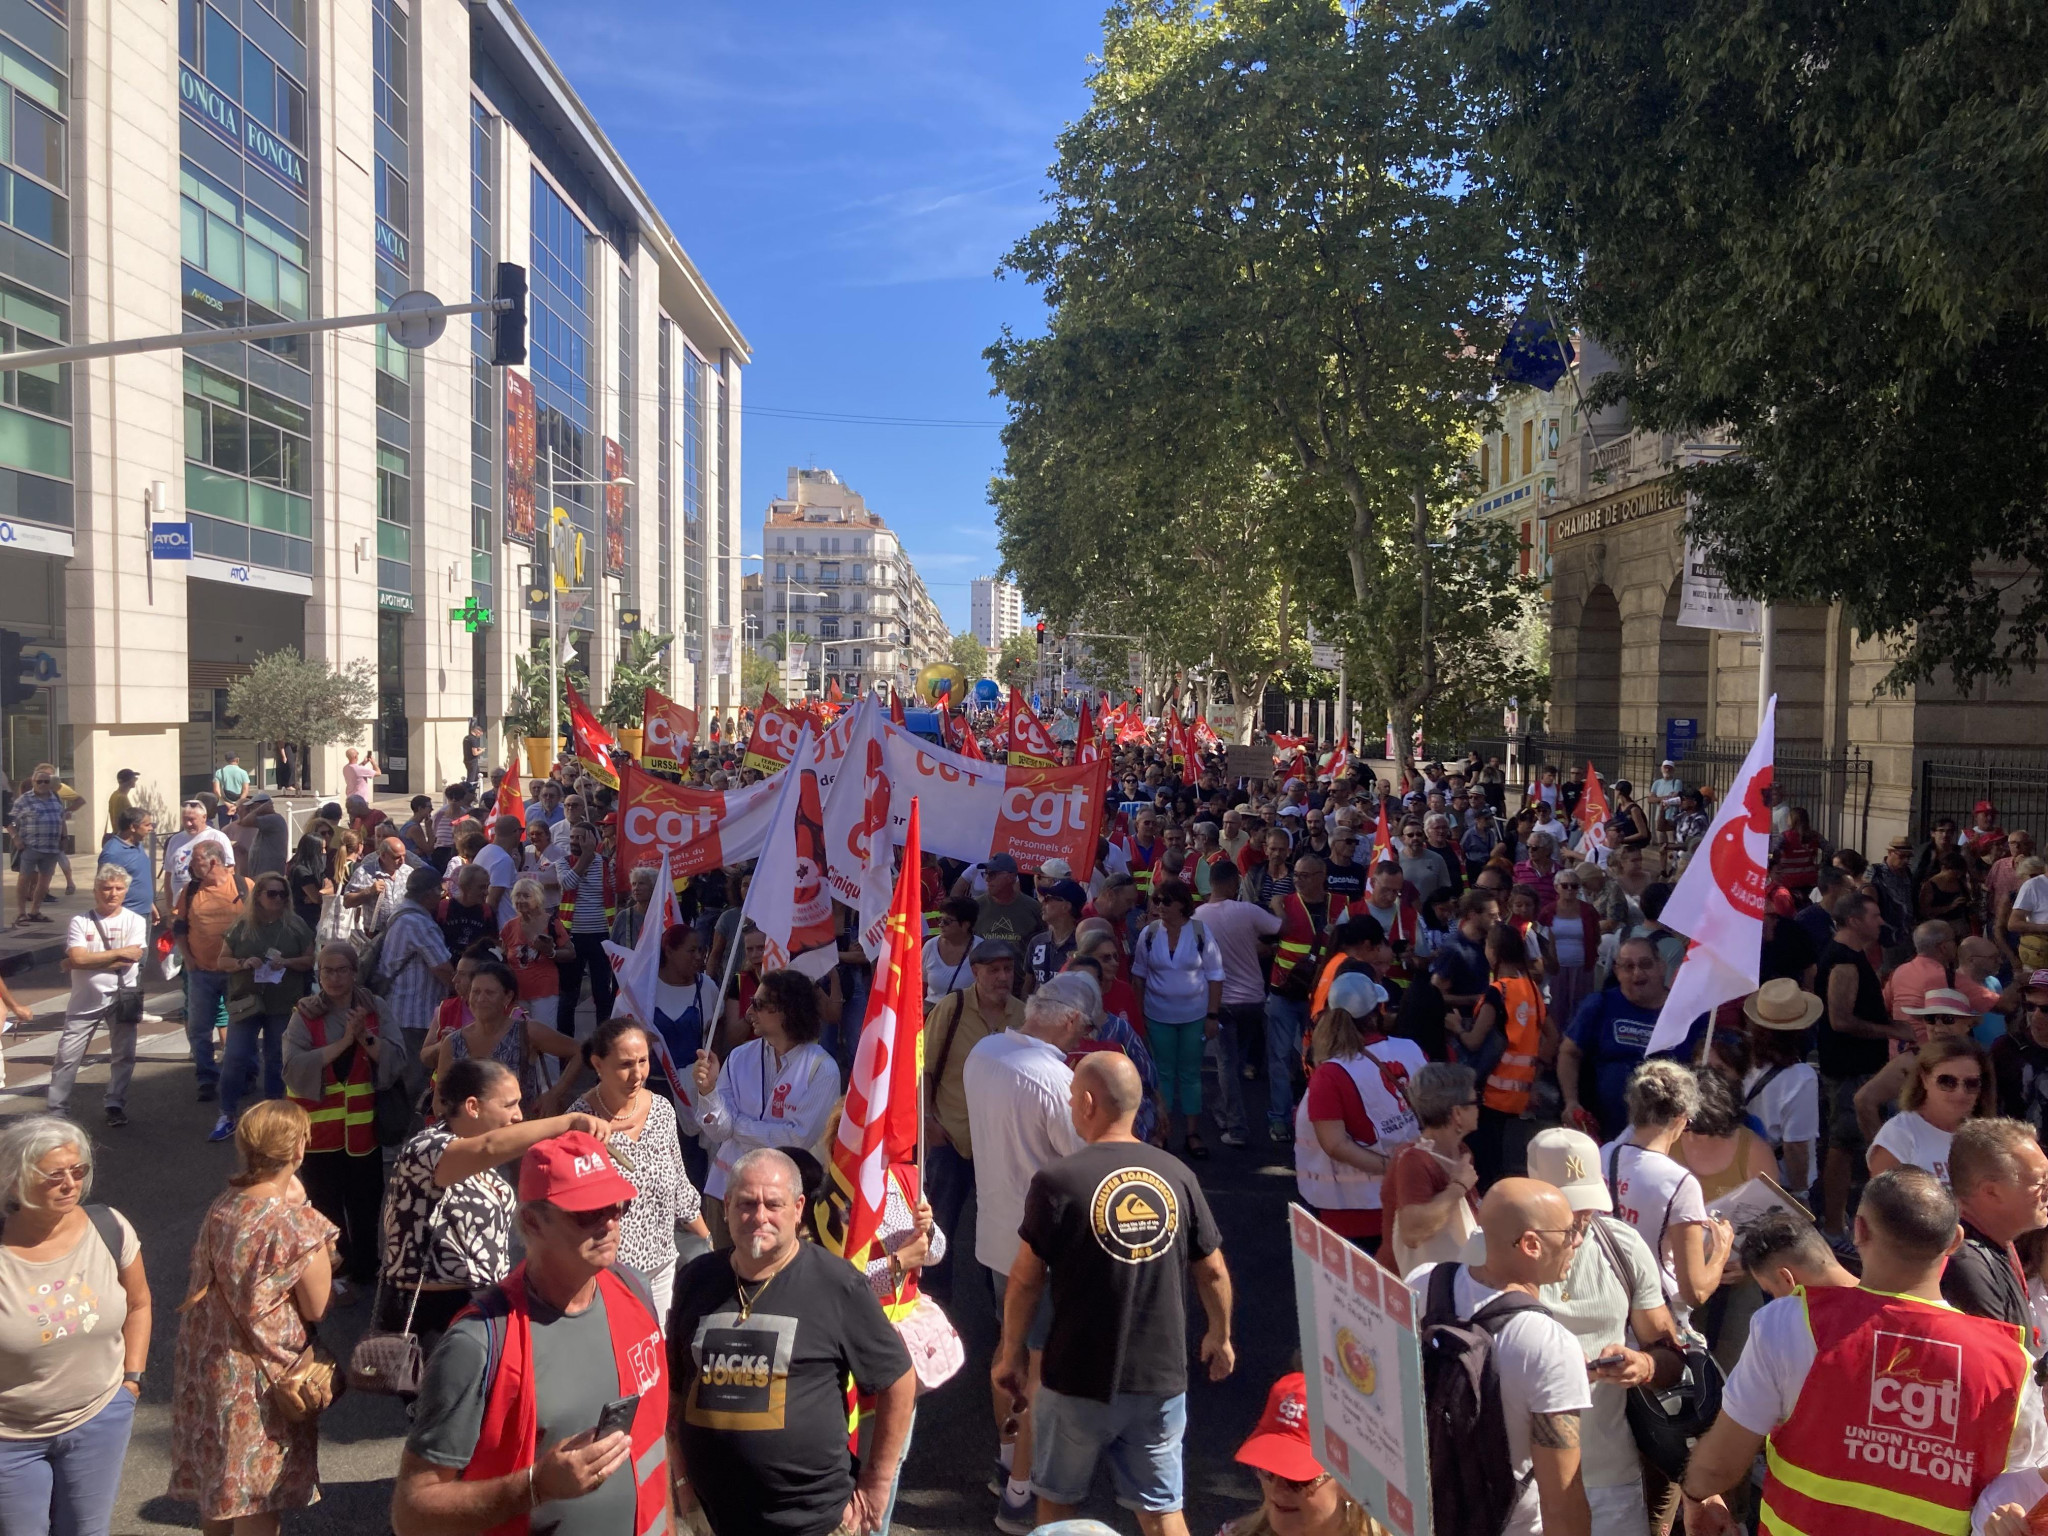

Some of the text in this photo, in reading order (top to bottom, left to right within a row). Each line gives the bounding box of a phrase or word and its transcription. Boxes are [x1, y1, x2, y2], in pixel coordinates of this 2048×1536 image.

[179, 66, 303, 184] ONCIA FONCIA
[375, 221, 406, 261] ONCIA
[0, 522, 17, 543] OL
[1558, 488, 1687, 539] CHAMBRE DE COMMERCE
[154, 532, 188, 546] ATOL
[230, 566, 249, 582] ATOL
[759, 712, 803, 761] cg
[1014, 713, 1050, 754] cg
[761, 758, 786, 769] TERRITO
[893, 815, 906, 826] ar
[1001, 784, 1089, 837] cgt
[624, 806, 718, 855] cgt
[1008, 836, 1073, 854] Personnels du
[828, 864, 861, 900] Cliniqu
[574, 1153, 592, 1178] FO
[1095, 1176, 1121, 1234] QUIKSILVER
[1120, 1171, 1176, 1211] BOARDSHORT
[702, 1367, 769, 1388] JONES
[1279, 1398, 1305, 1419] cgt
[1873, 1377, 1960, 1429] cgt
[1844, 1438, 1973, 1487] TOULON
[1845, 1425, 1975, 1464] UNION LOCALE
